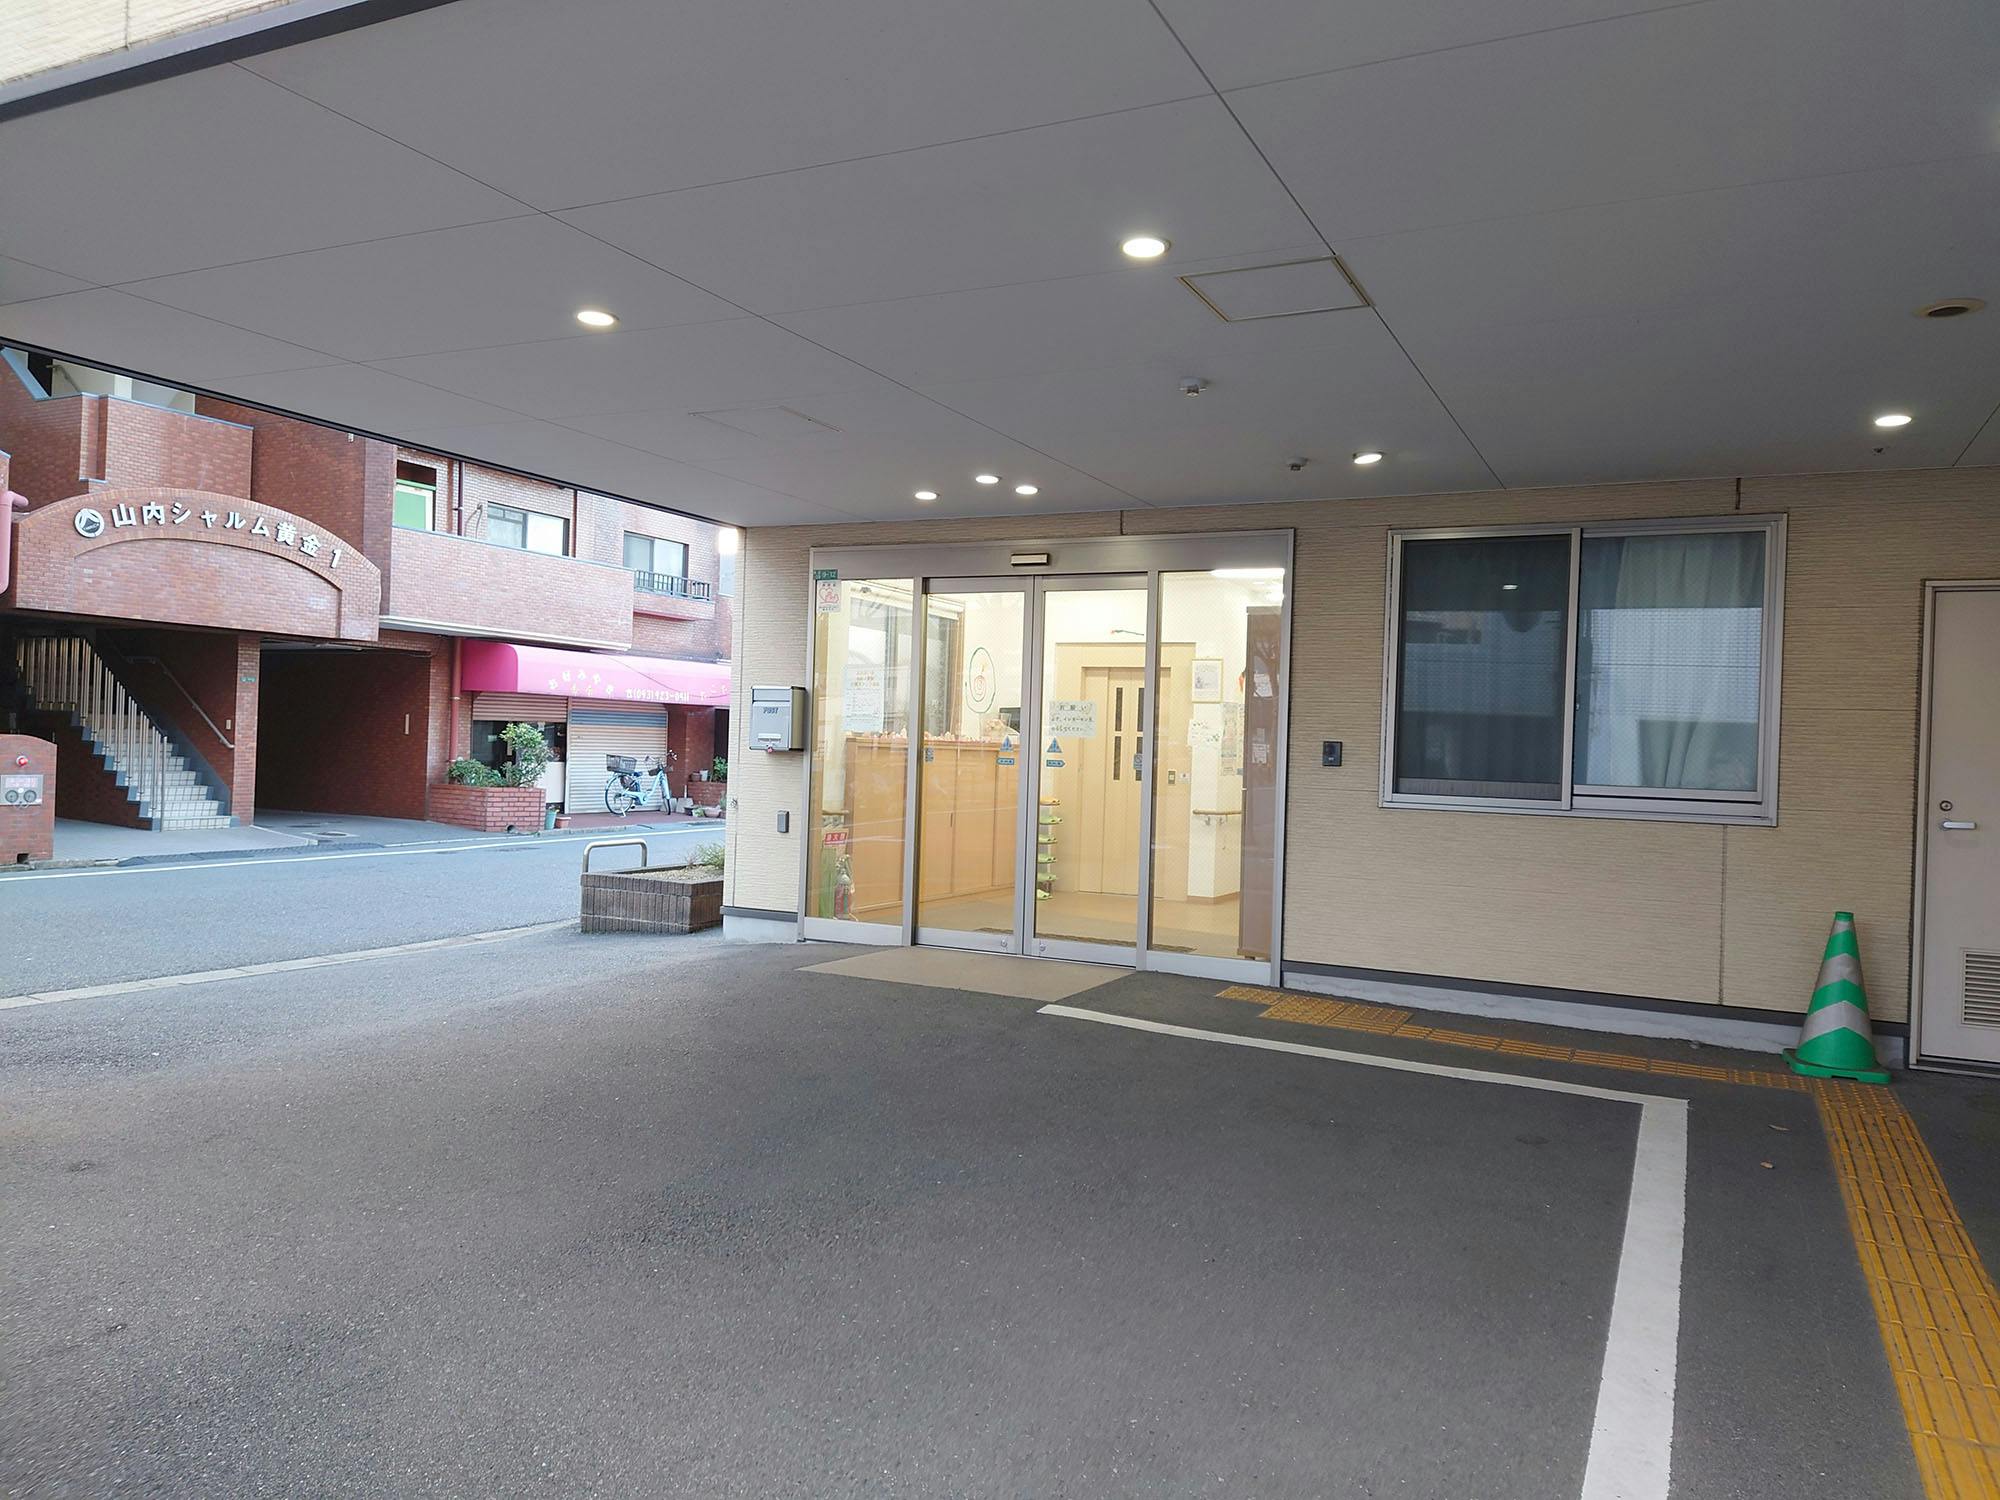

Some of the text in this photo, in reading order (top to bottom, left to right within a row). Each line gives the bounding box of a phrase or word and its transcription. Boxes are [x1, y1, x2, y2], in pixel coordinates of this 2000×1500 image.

[111, 501, 342, 569] 山内シャルム黄金1
